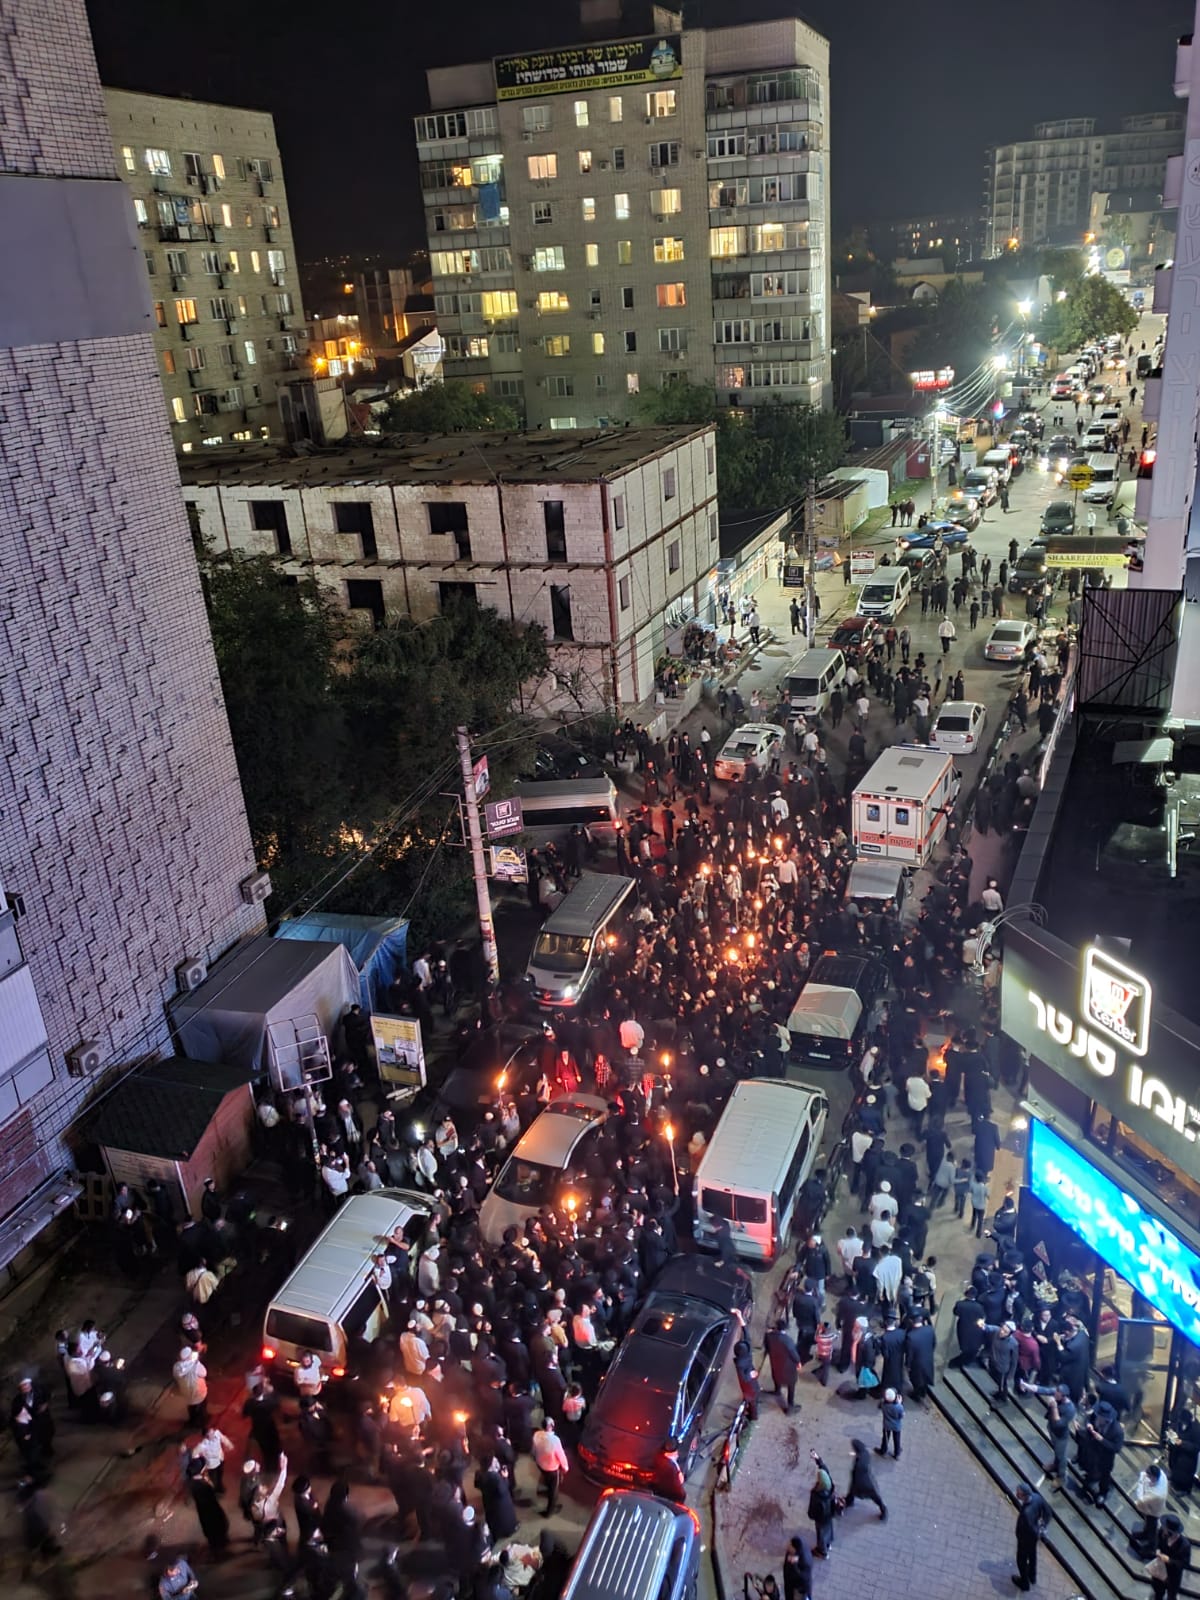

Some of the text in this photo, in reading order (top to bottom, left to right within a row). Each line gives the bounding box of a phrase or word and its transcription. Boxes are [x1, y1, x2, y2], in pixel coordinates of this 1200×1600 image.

[557, 50, 584, 65] רבינו
[586, 48, 603, 61] של
[606, 43, 643, 59] הקיבוץ
[532, 54, 554, 70] זועק
[598, 59, 628, 73] שמור
[569, 63, 595, 77] אותי
[1028, 990, 1117, 1077] סנטר
